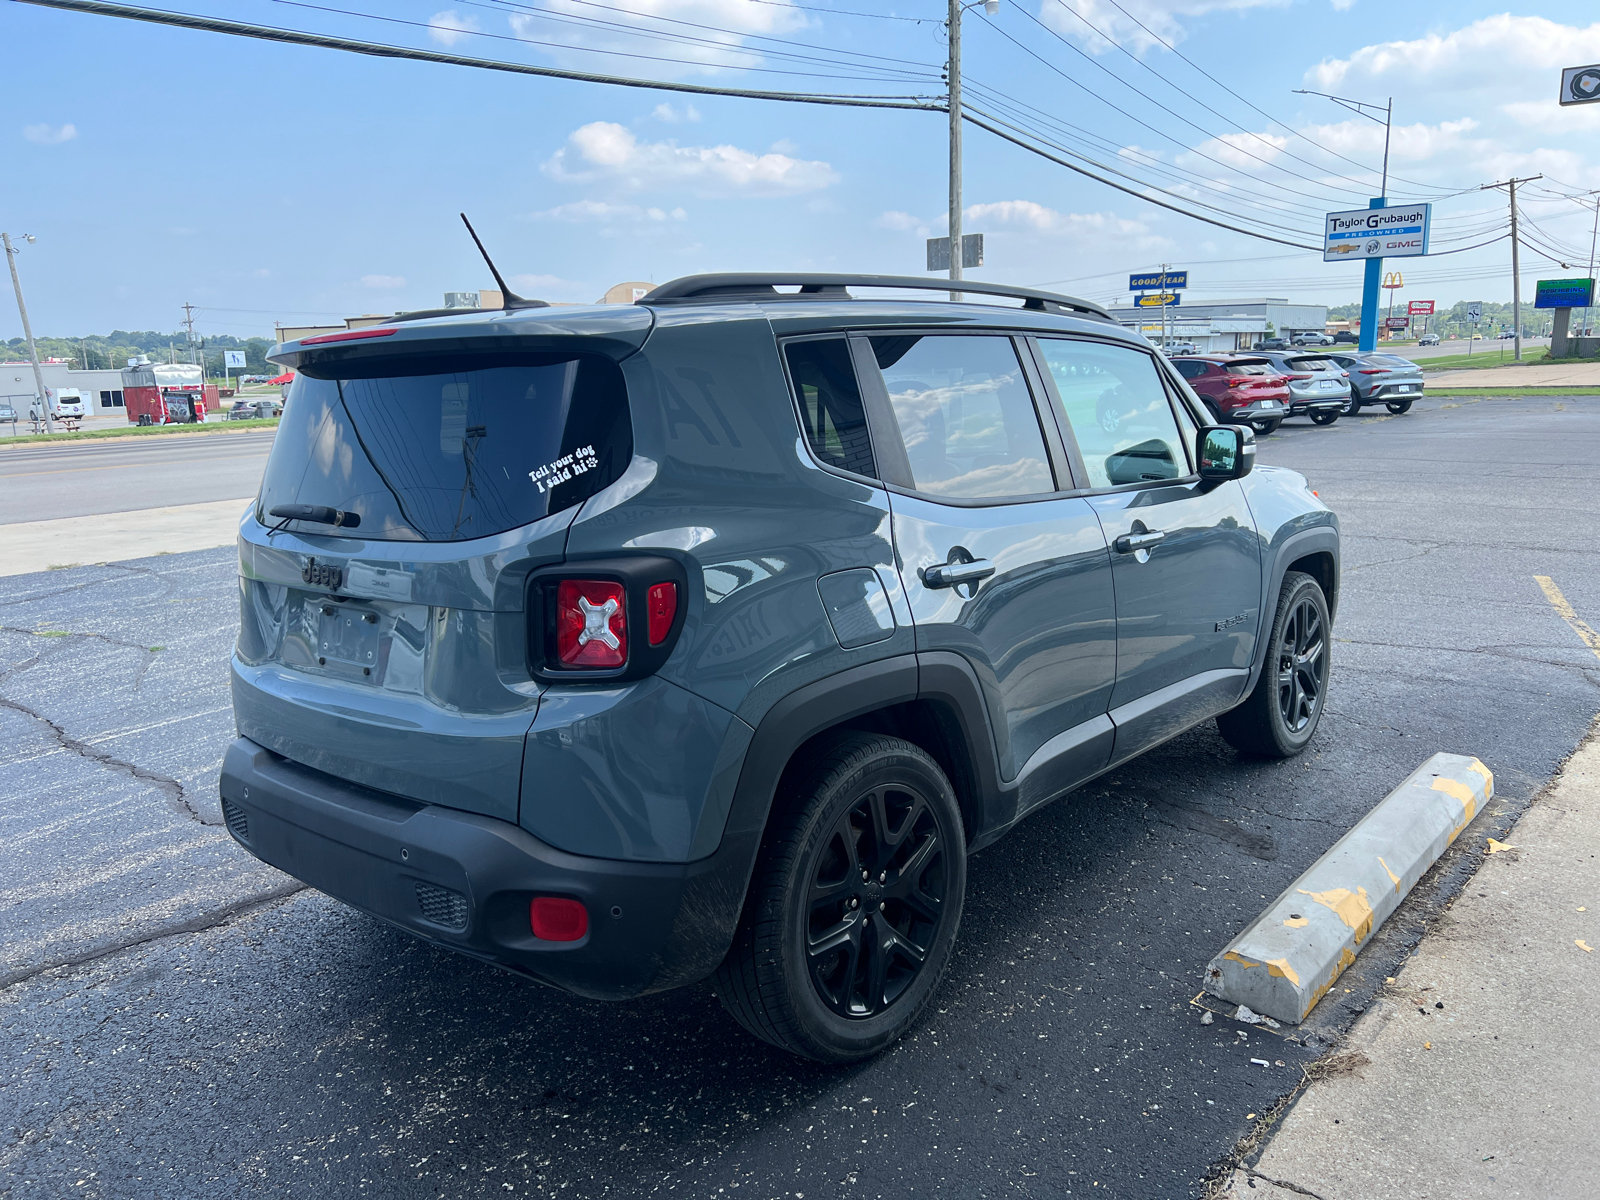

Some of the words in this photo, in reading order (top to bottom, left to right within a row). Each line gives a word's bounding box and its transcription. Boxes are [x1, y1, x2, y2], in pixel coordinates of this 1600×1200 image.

[1330, 218, 1364, 231] Taylor
[1367, 212, 1422, 228] Grubaugh
[1345, 229, 1404, 237] PRE-OWNED
[1386, 240, 1422, 249] GMC
[528, 465, 550, 482] Tell
[550, 454, 573, 473] your
[575, 445, 595, 459] dog
[536, 481, 545, 493] I
[546, 467, 572, 488] said
[572, 459, 588, 475] hi
[302, 557, 342, 592] Jeep
